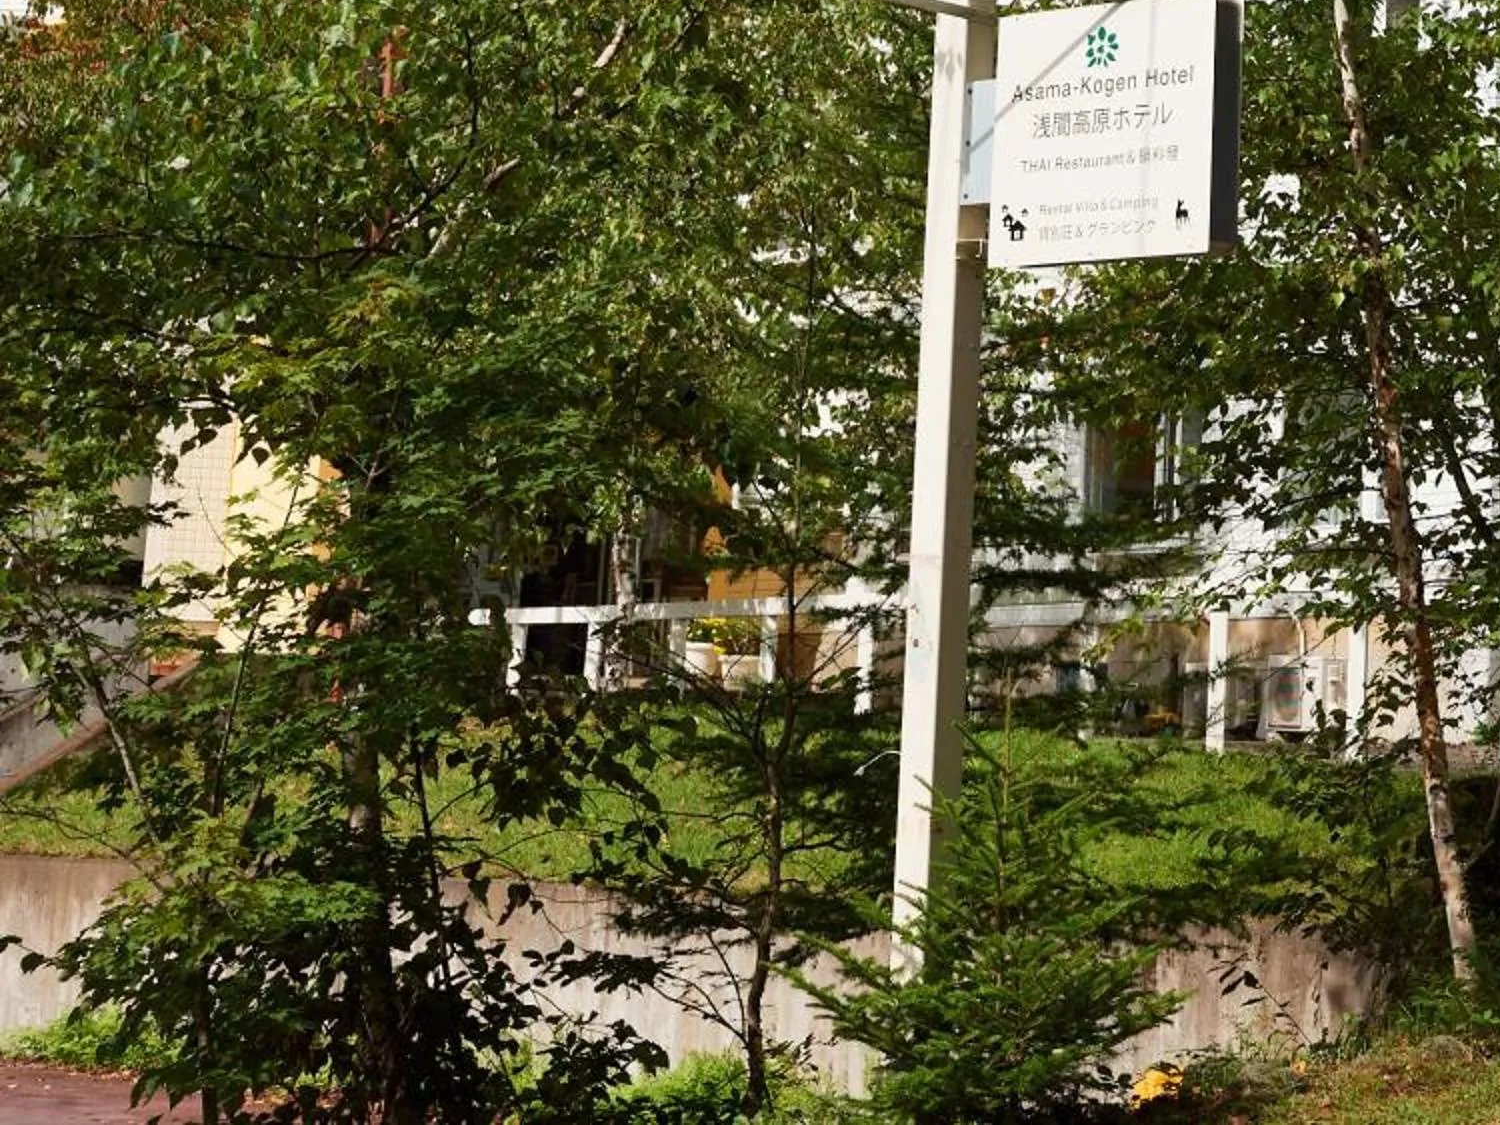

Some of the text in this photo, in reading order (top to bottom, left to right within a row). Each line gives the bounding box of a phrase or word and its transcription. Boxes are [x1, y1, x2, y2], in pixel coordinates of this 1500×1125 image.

[1012, 65, 1195, 103] Asama-Kogen Hotel
[1032, 102, 1174, 139] 浅間高原ホテル
[1021, 159, 1051, 173] THAI
